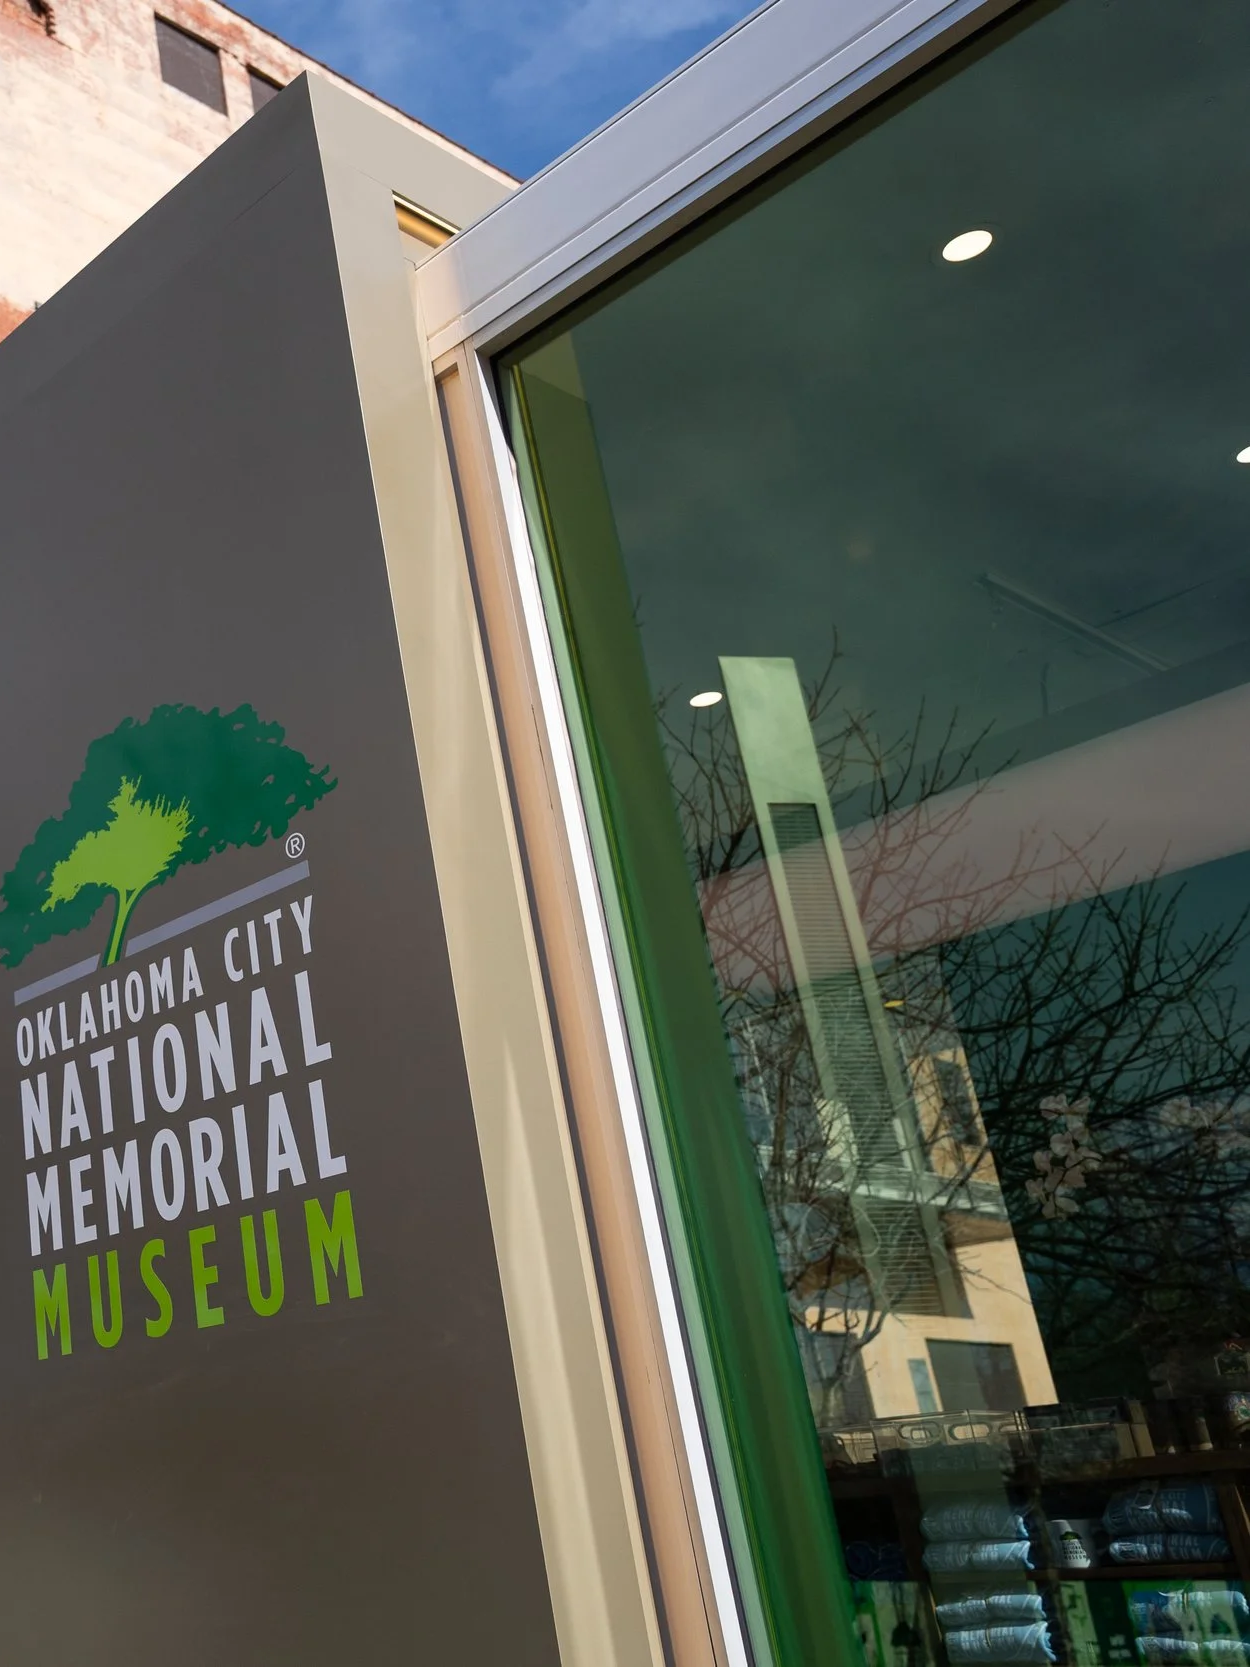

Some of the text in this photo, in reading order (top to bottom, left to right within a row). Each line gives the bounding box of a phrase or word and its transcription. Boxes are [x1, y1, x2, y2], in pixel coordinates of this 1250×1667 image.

[16, 894, 313, 1067] OKLAHOMA CITY
[20, 969, 332, 1161] NATIONAL
[26, 1079, 348, 1257] MEMORIAL
[32, 1189, 364, 1361] MUSEUM
